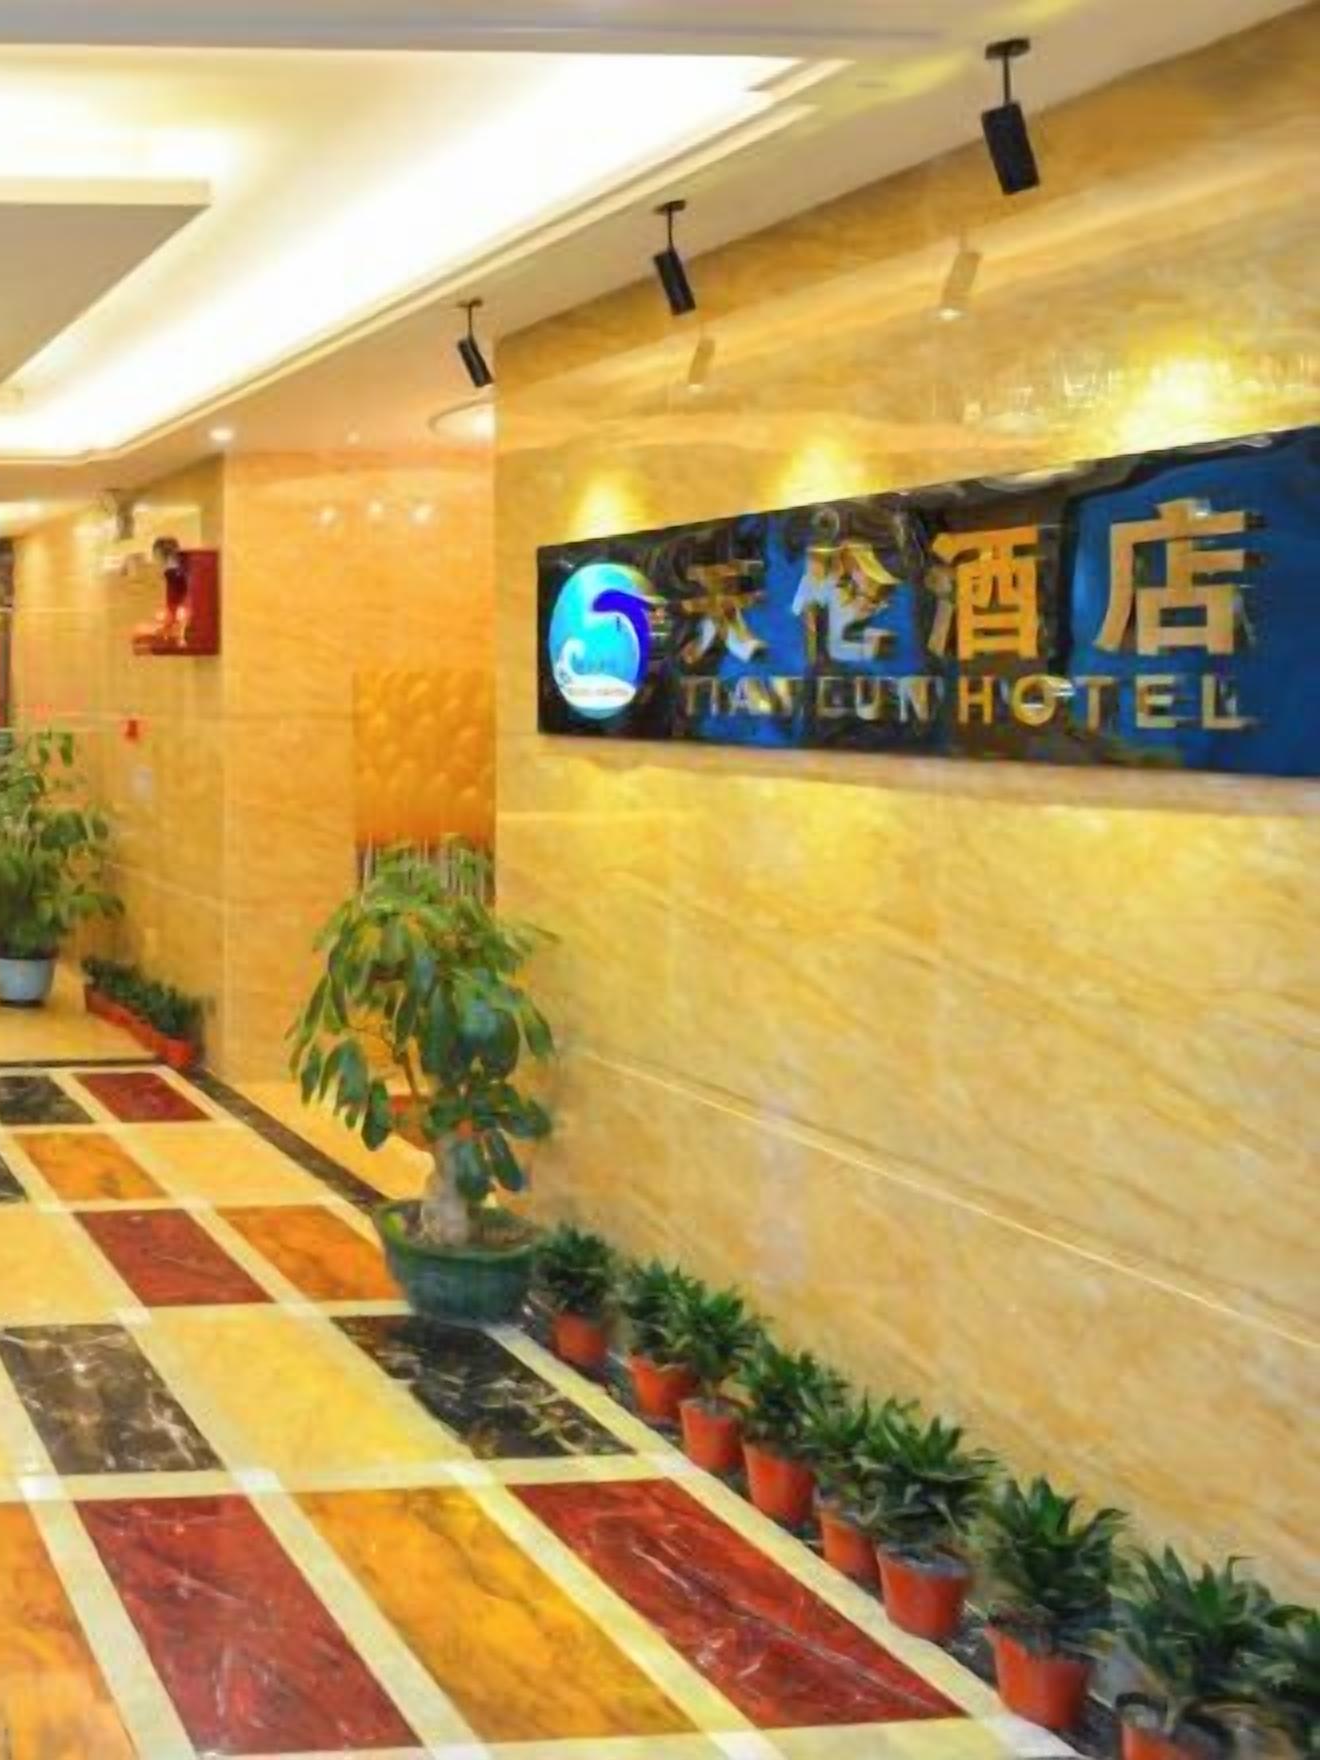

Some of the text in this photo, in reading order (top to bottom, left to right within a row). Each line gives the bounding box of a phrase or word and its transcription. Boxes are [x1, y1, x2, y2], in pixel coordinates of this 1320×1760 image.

[679, 497, 1252, 665] 天伦酒店
[957, 673, 1252, 731] HOTEL
